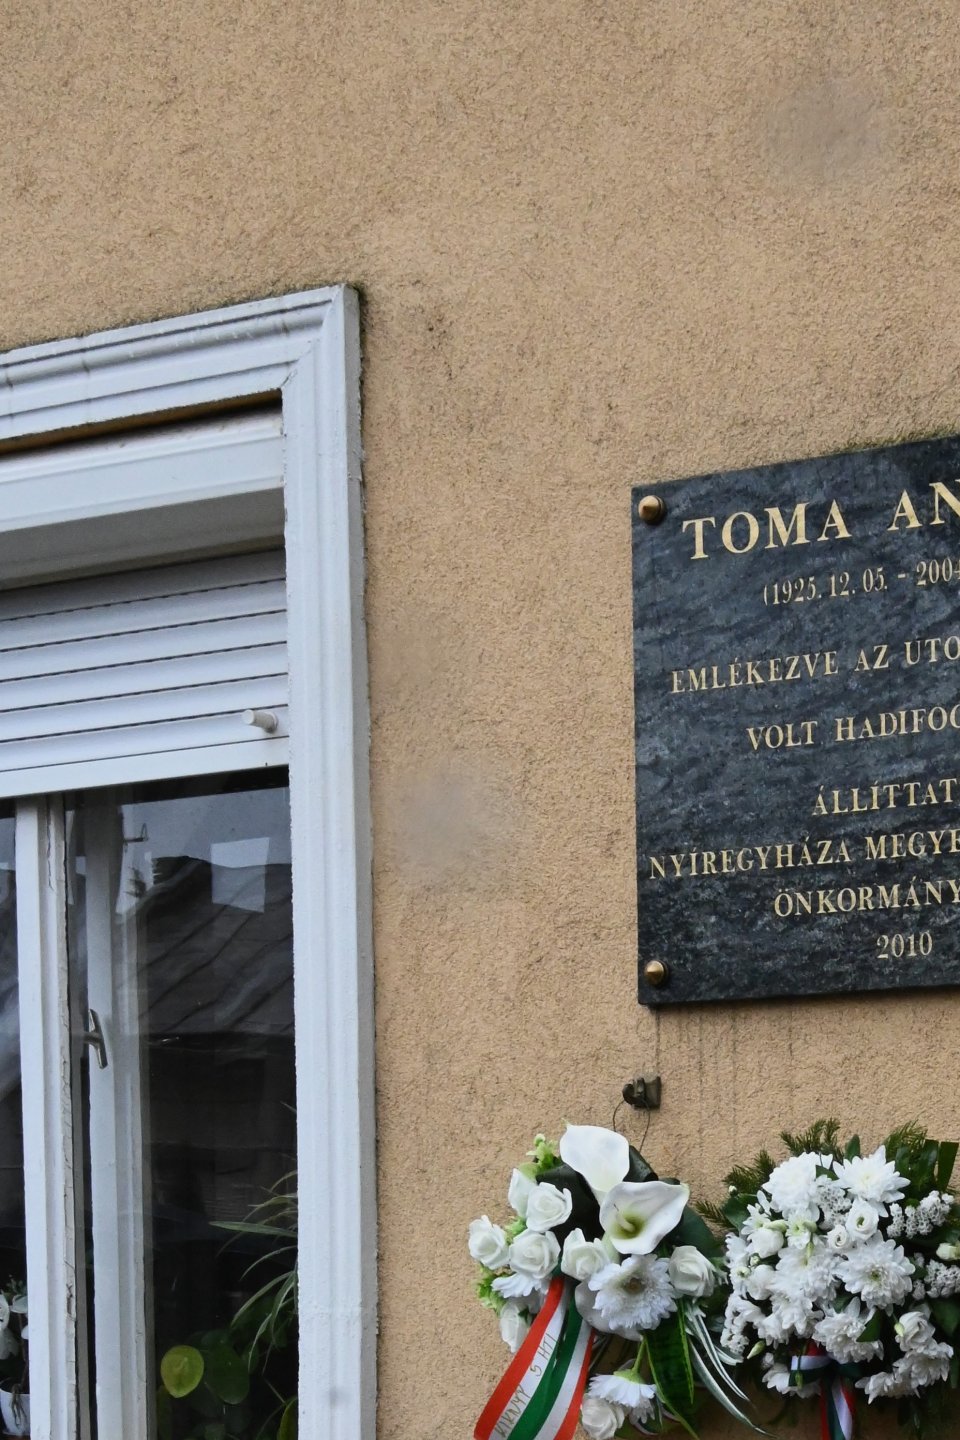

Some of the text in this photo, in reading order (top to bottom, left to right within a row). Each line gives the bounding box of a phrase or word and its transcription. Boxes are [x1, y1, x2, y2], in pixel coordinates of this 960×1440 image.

[682, 500, 852, 560] TOMA
[763, 577, 822, 605] (1925.
[830, 571, 856, 597] 12.
[862, 567, 888, 593] 05.
[671, 650, 838, 693] EMLÉKEZVE
[856, 645, 888, 671] AZ
[747, 720, 818, 751] VOLT
[649, 835, 852, 880] NYÍREGYHÁZA
[877, 931, 932, 958] 2010
